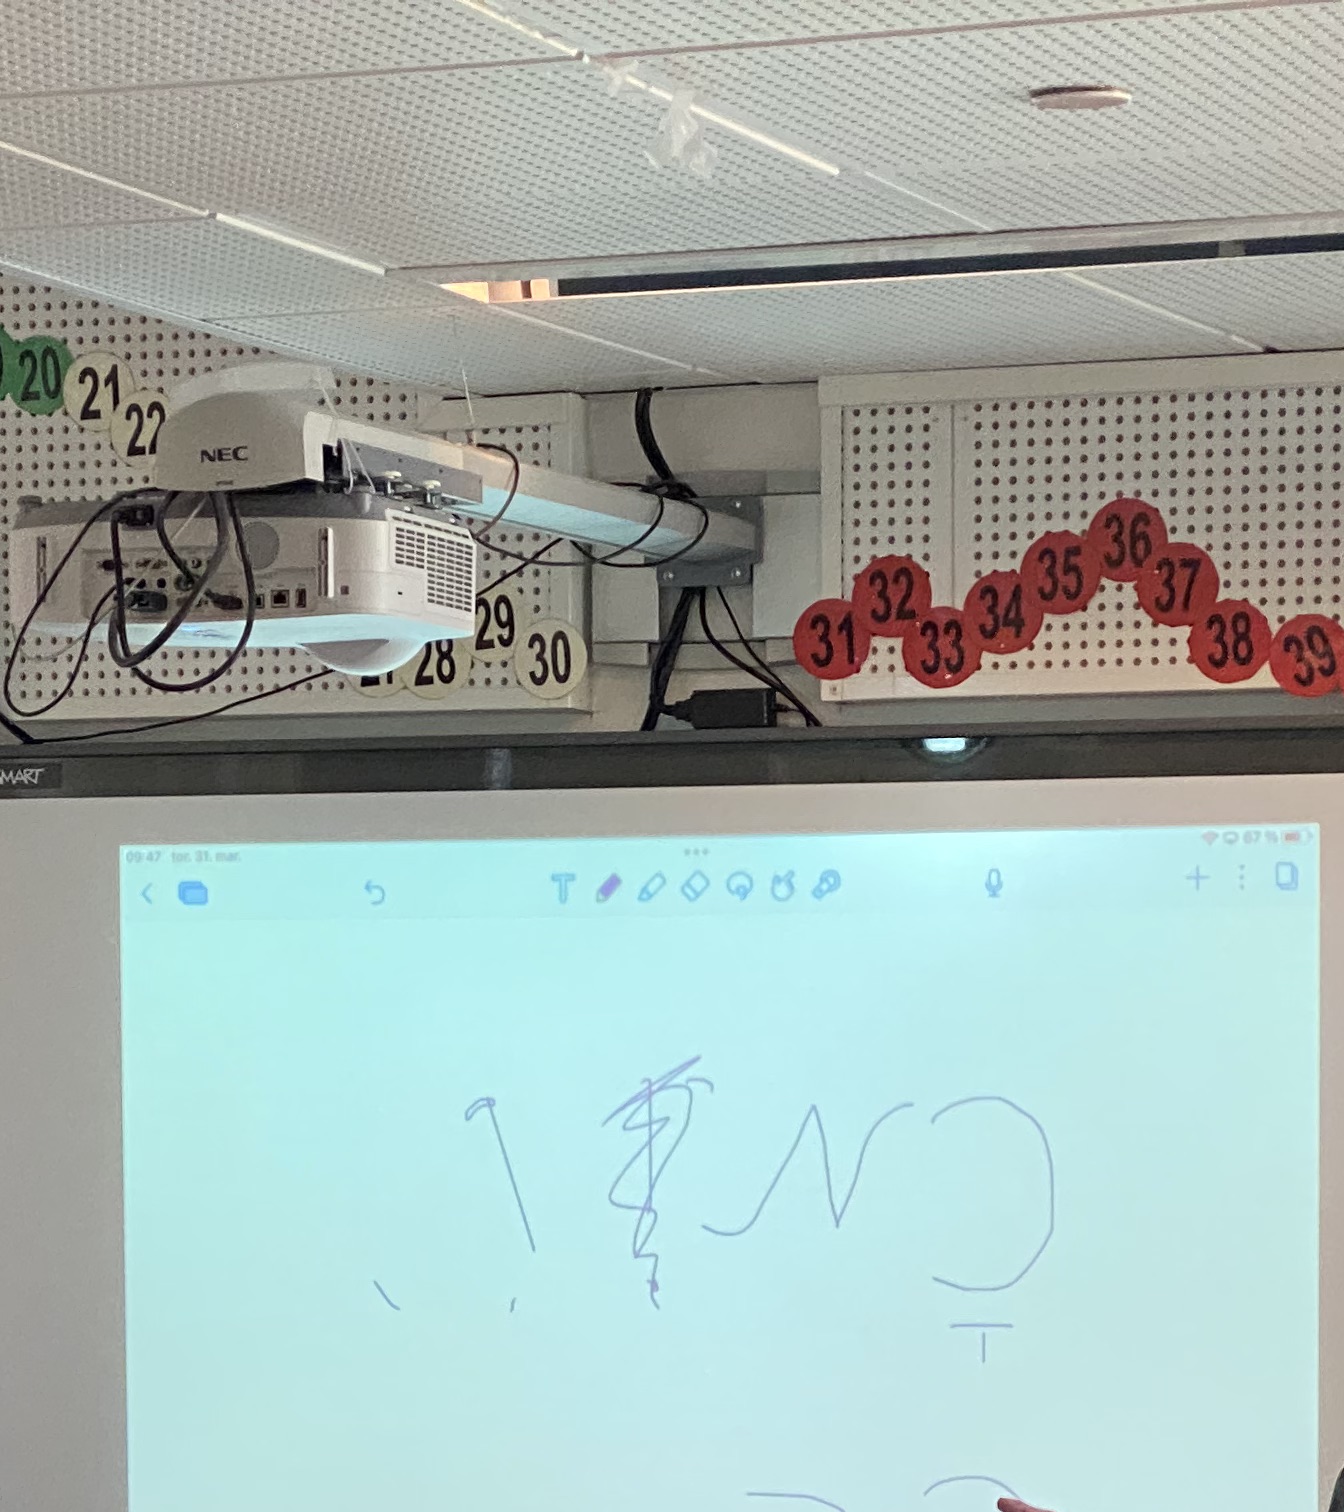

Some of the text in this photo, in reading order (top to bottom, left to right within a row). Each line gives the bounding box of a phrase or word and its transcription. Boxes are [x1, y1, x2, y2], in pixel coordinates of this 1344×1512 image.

[19, 346, 62, 400] 20
[78, 364, 166, 457] 21 22
[200, 445, 248, 463] NEC
[414, 595, 572, 686] 28 29 30
[809, 615, 857, 669] 31
[869, 566, 916, 624] 32
[919, 619, 965, 674] 33
[979, 584, 1024, 639] 34
[1038, 545, 1084, 600] 35
[1103, 510, 1151, 568] 36
[1153, 558, 1200, 613] 37
[1206, 612, 1253, 668] 38
[1284, 625, 1335, 686] 39
